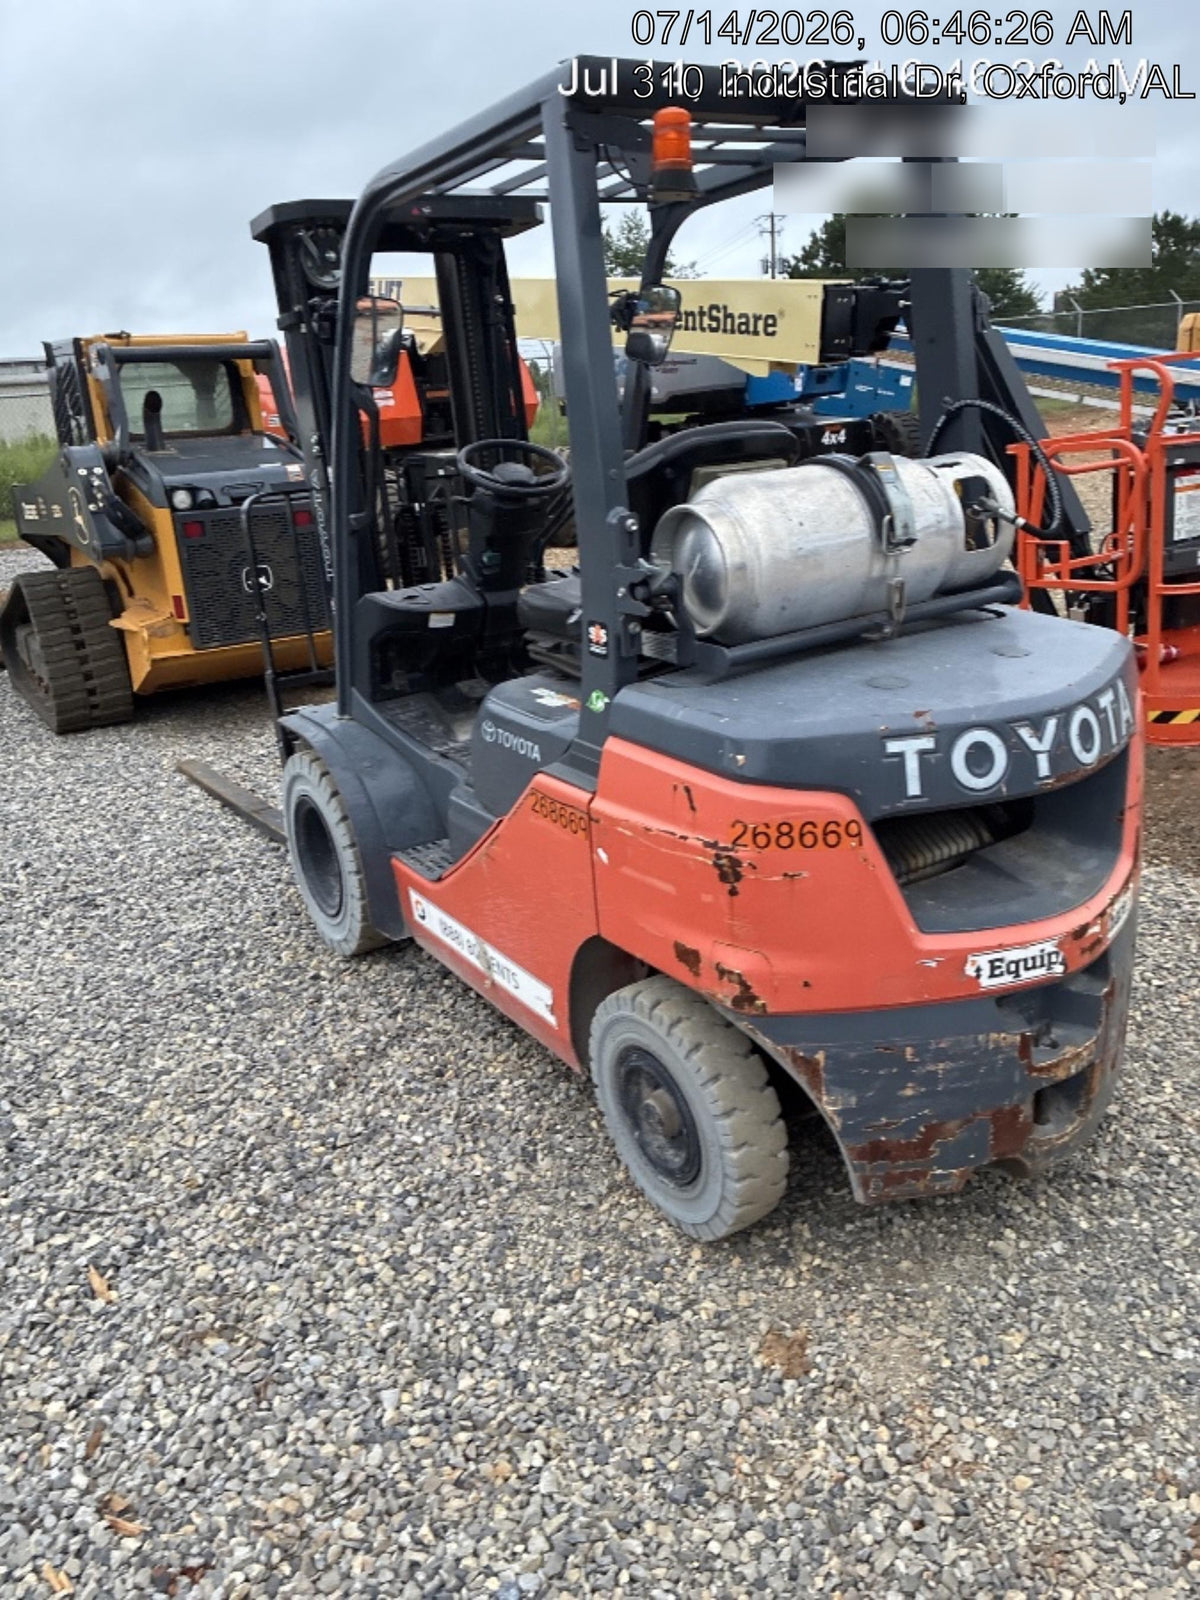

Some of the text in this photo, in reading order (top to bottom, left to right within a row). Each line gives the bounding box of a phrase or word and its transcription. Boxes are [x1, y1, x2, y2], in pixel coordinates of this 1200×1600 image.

[674, 304, 778, 337] entShare
[496, 728, 542, 762] TOYOTA
[885, 678, 1134, 798] TOYOTA
[529, 790, 590, 838] 268669
[731, 819, 863, 849] 268669
